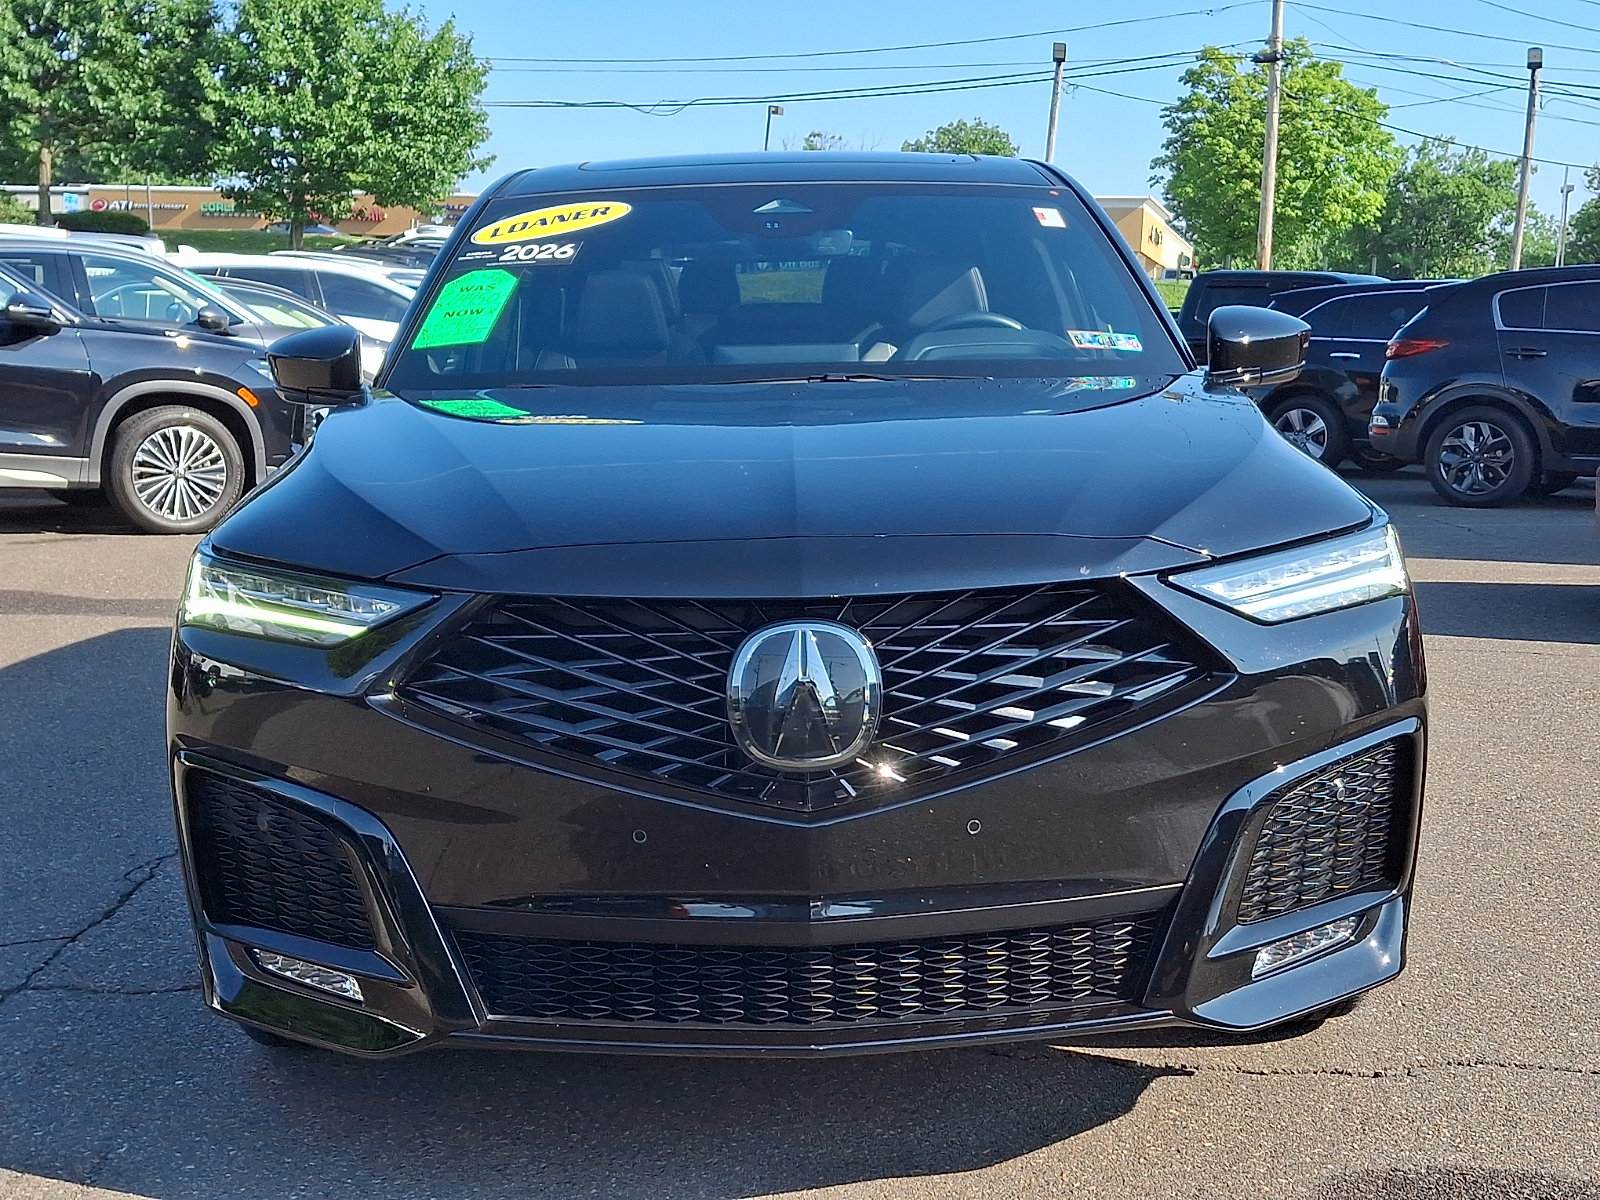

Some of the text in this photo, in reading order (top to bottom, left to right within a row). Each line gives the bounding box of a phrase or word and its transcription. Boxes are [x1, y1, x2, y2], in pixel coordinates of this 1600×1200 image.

[108, 200, 134, 211] ATI
[489, 206, 611, 239] LOANER
[498, 243, 576, 262] 2026
[459, 283, 497, 293] WAS
[443, 307, 485, 319] NOW
